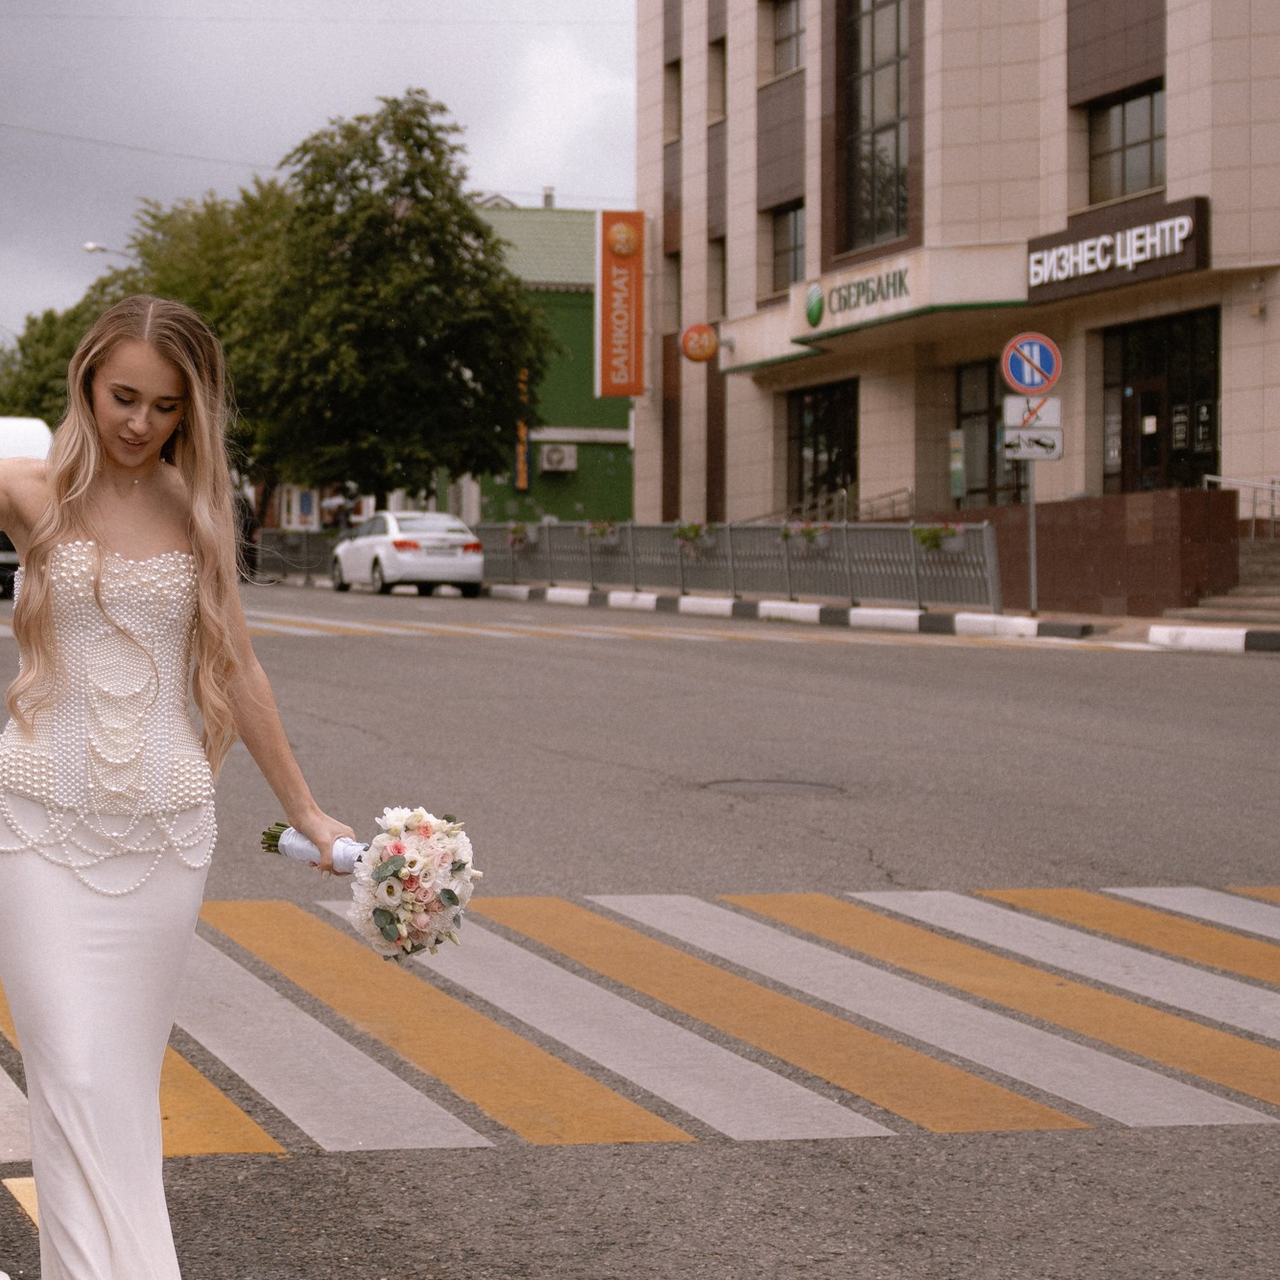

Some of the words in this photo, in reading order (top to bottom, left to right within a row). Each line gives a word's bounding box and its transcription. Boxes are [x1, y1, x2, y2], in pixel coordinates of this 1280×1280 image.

[1029, 234, 1115, 287] БИЗНЕС
[1115, 215, 1193, 271] ЦЕНТР
[611, 266, 629, 385] БАНКОМАТ
[828, 266, 910, 315] СБЕРБАНК
